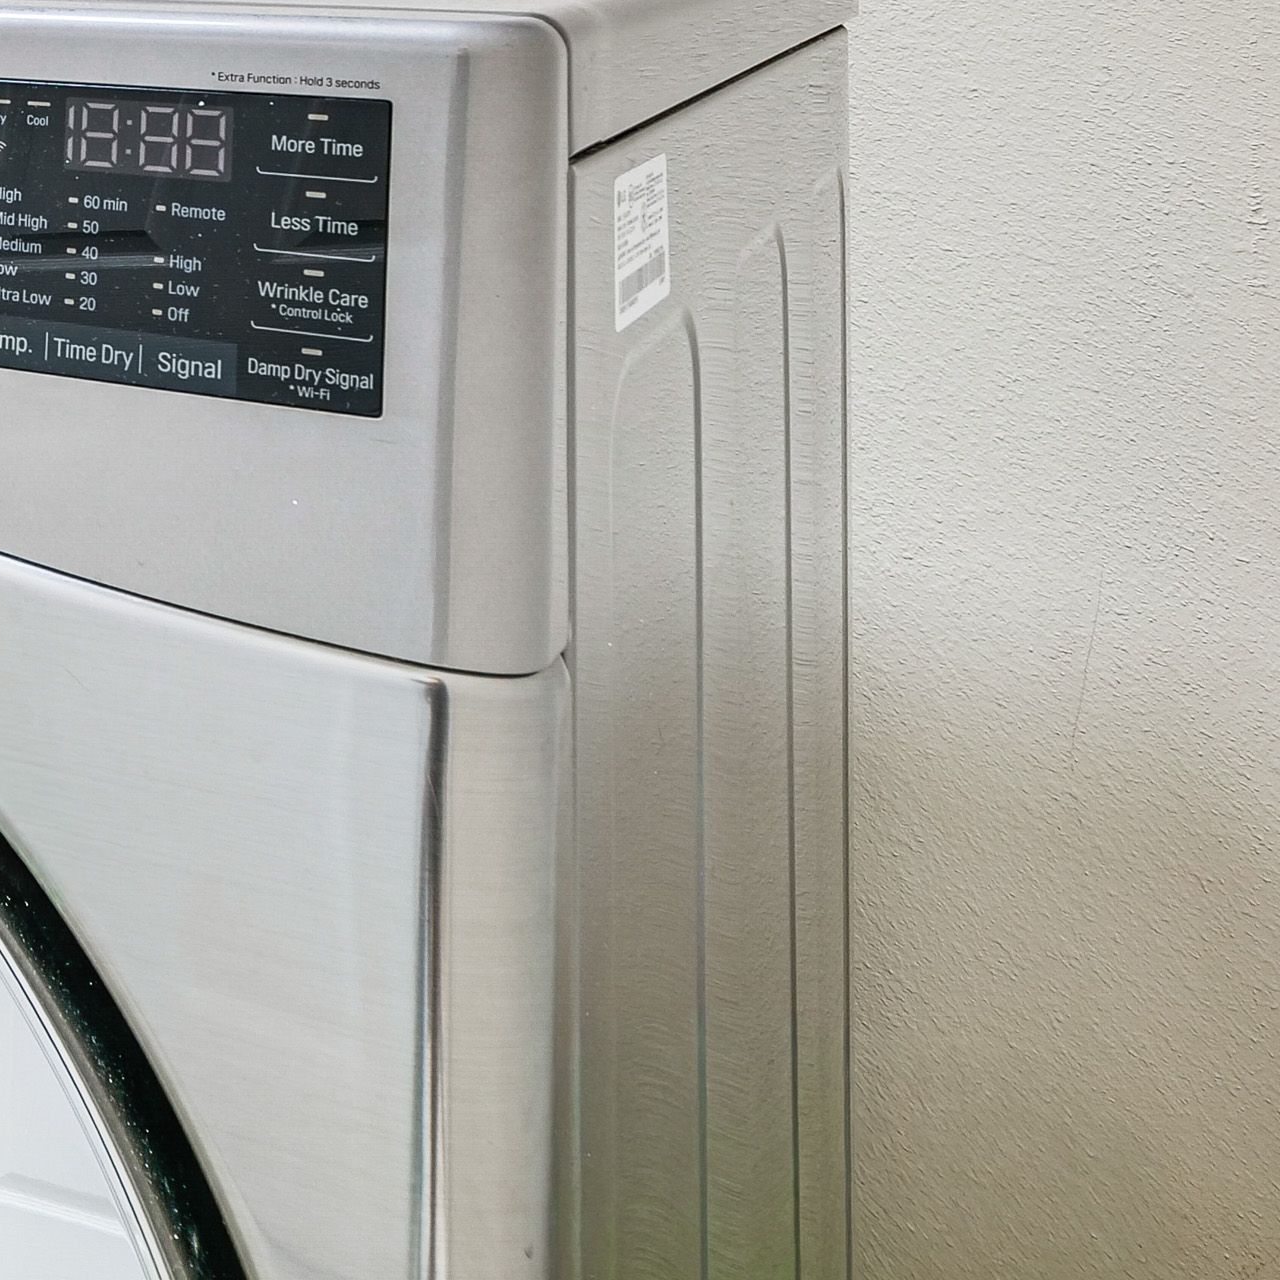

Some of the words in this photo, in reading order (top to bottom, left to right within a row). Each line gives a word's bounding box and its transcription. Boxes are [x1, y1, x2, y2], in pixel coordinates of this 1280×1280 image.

[218, 72, 245, 83] Extra
[247, 73, 291, 85] Function
[299, 76, 323, 87] Hold
[326, 77, 333, 87] 3
[335, 79, 381, 90] seconds
[26, 114, 49, 126] Cool
[271, 135, 316, 153] More
[320, 138, 364, 157] Time
[83, 195, 100, 210] 60
[103, 198, 128, 212] min
[171, 202, 226, 221] Remote
[18, 213, 48, 230] High
[82, 220, 99, 235] 50
[271, 211, 311, 231] Less
[315, 215, 359, 236] Time
[81, 246, 98, 260] 40
[169, 255, 202, 273] High
[80, 271, 97, 286] 30
[168, 280, 200, 297] Low
[257, 280, 324, 303] Wrinkle
[328, 288, 369, 309] Care
[23, 289, 52, 306] Low
[79, 296, 96, 311] 20
[167, 307, 190, 322] Off
[279, 304, 322, 319] Control
[324, 309, 354, 324] Lock
[53, 337, 96, 361] Time
[101, 344, 134, 371] Dry
[157, 352, 222, 380] Signal
[248, 357, 291, 381] Damp
[294, 364, 321, 386] Dry
[325, 368, 374, 390] Signal
[297, 385, 330, 401] Wi-Fi
